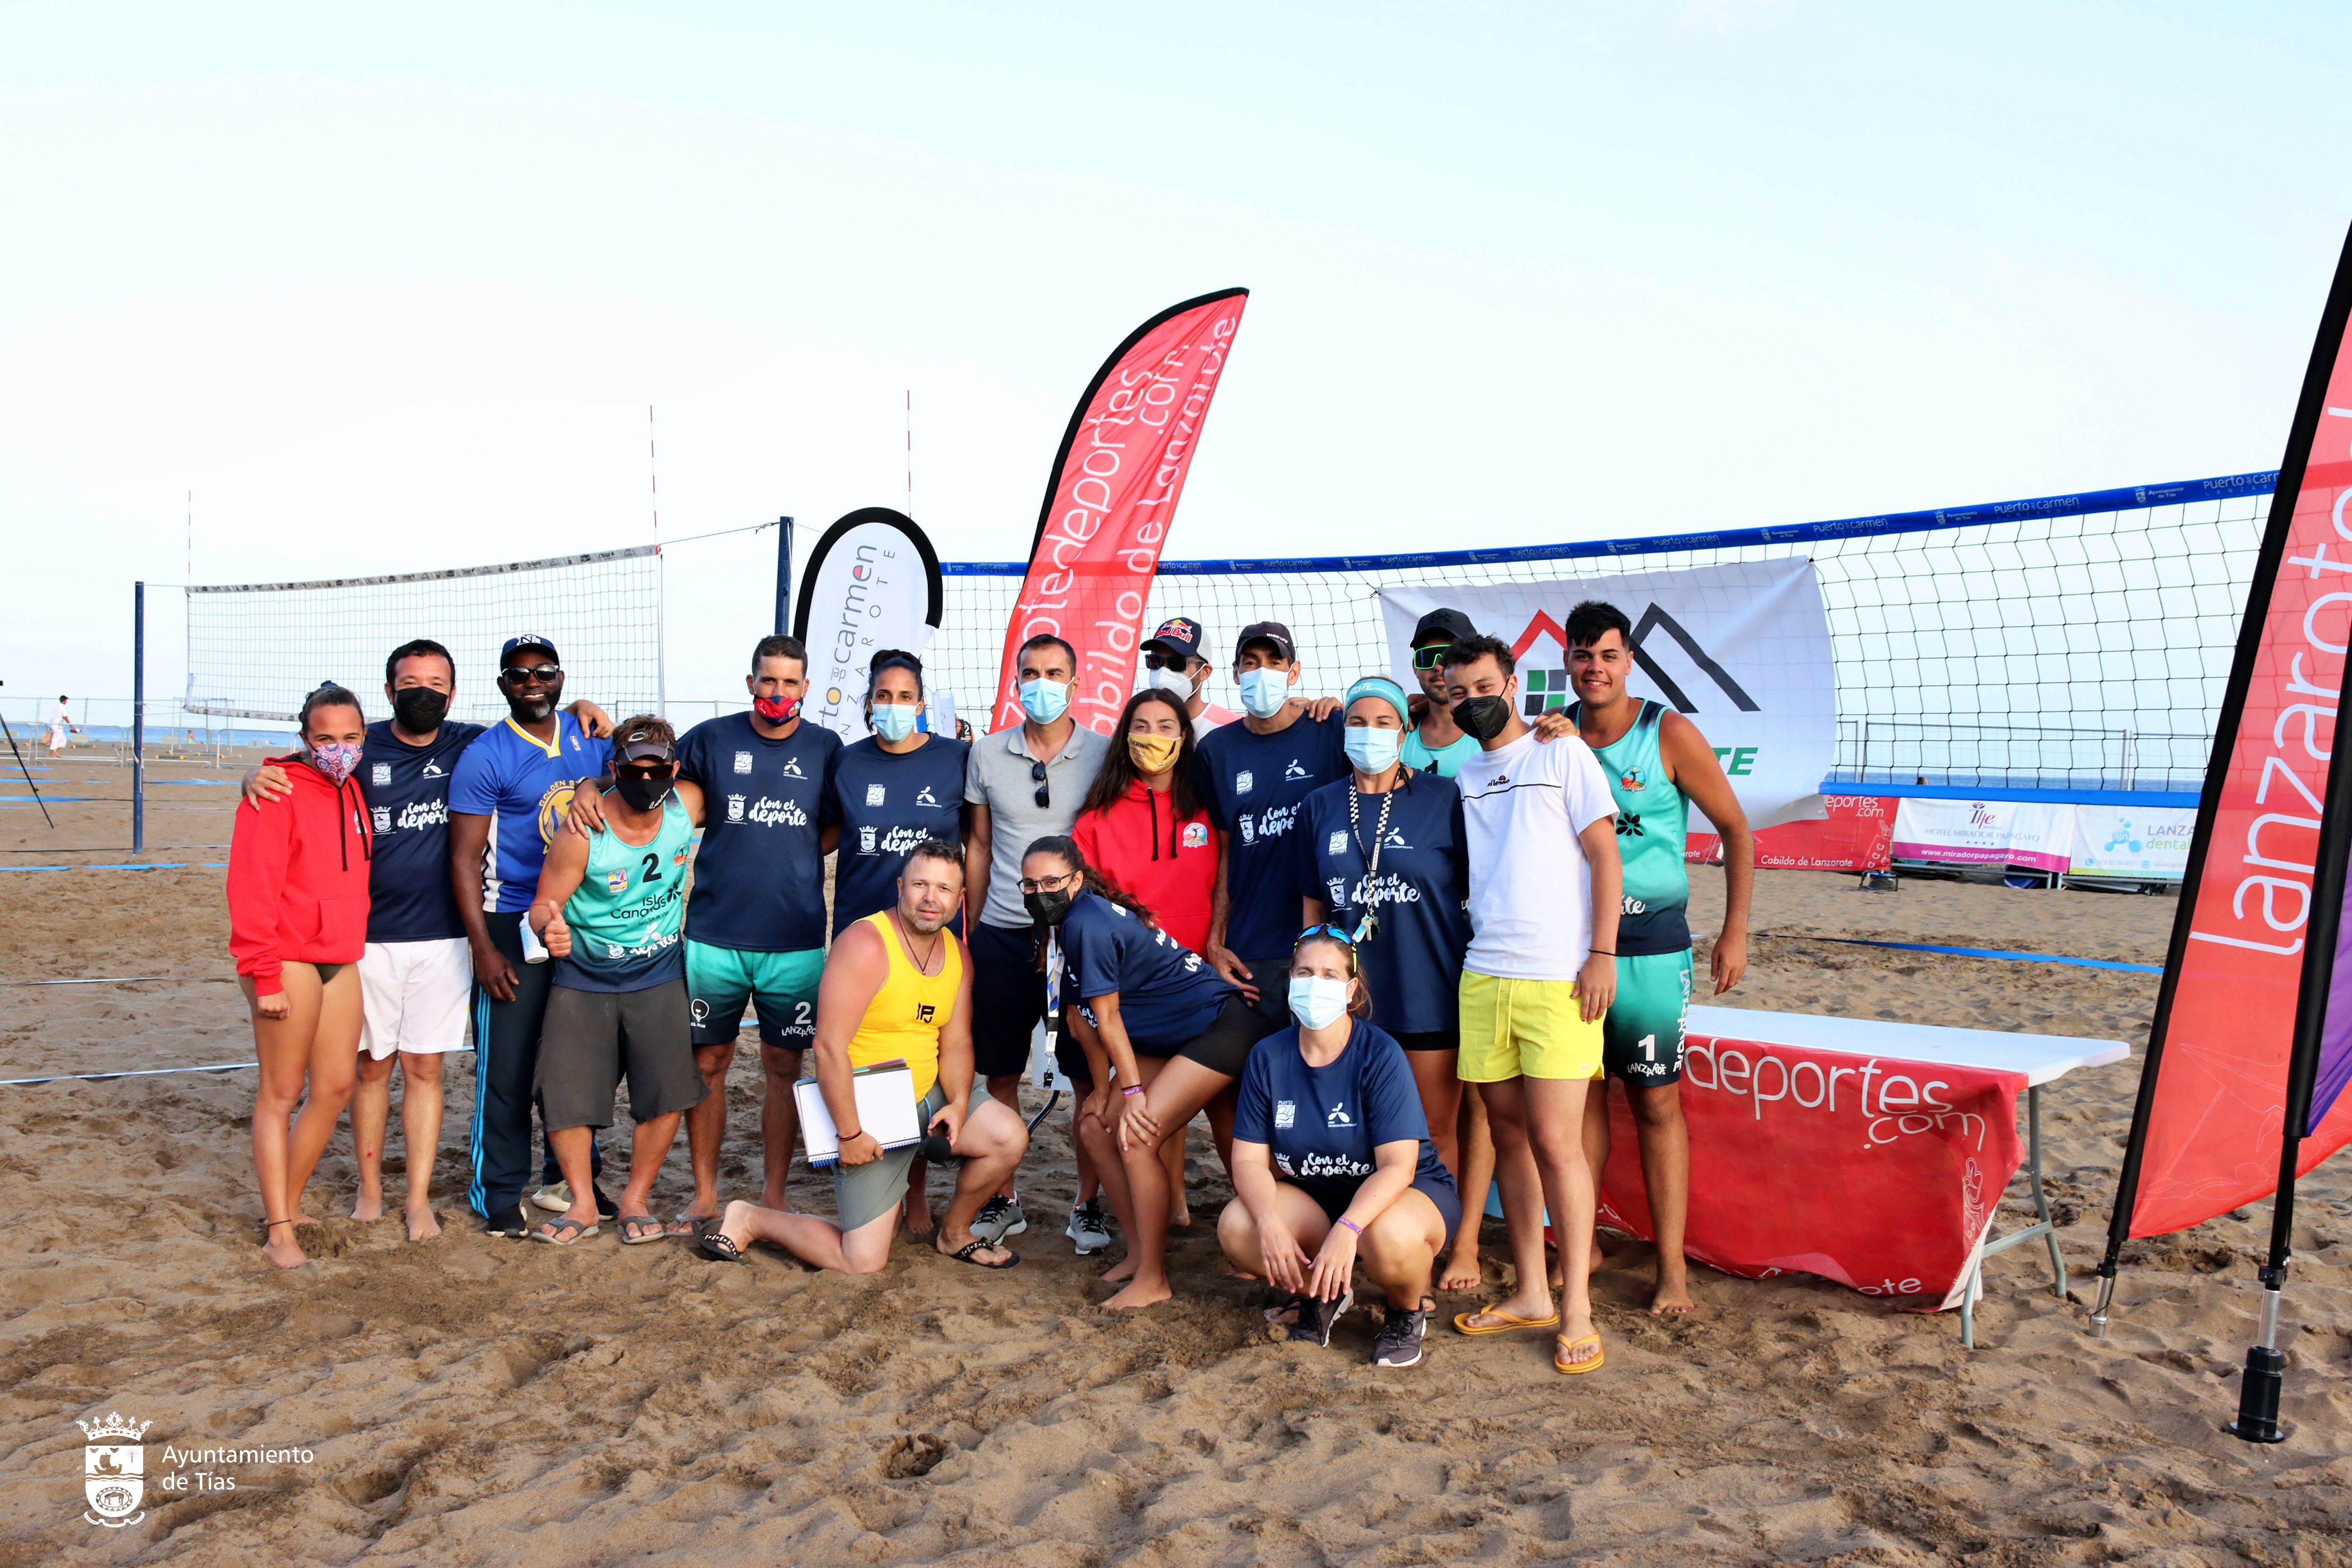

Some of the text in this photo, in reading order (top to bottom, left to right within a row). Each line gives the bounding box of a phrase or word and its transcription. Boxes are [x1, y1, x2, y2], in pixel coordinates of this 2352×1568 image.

[2204, 476, 2244, 490] Puerto
[1994, 500, 2029, 514] Puerto
[2036, 496, 2080, 509] carmen
[1813, 520, 1844, 533] Puerto
[1850, 517, 1888, 529] carmen
[1653, 534, 1720, 546] Puerto carmen
[1539, 546, 1570, 554] carmen
[834, 544, 877, 664] carmen
[1078, 590, 1142, 737] abildo
[1117, 520, 1163, 573] de
[1171, 628, 1193, 643] Bull
[840, 548, 896, 735] NZAROTE
[831, 666, 846, 682] del
[2188, 405, 2352, 956] lanzarot
[964, 724, 970, 735] 2
[1712, 747, 1759, 775] TE
[1487, 778, 1510, 787] ellesse
[539, 780, 566, 807] GOLDEN
[407, 798, 443, 815] Con el
[760, 796, 796, 810] Con el
[397, 806, 449, 831] deport
[748, 801, 808, 828] deporte
[1267, 807, 1289, 821] Con
[1855, 807, 1885, 817] .com
[892, 825, 929, 839] Con el
[1258, 815, 1295, 837] depo
[2147, 825, 2195, 836] LANZA
[1925, 828, 2040, 842] HOTEL MIRADOR PAPAGAYO
[1761, 855, 1853, 867] Cabildo de Lanzarote
[1921, 849, 2036, 863] www.miradorpapagayo.com
[642, 853, 662, 883] 2
[1362, 872, 1400, 889] Cn el
[794, 1001, 811, 1025] 2
[782, 1025, 817, 1037] LANZARO
[1638, 1034, 1655, 1061] 1
[1627, 1062, 1667, 1077] LANZAROTE
[1684, 1038, 1953, 1120] deportes
[1863, 1110, 1986, 1152] .com
[1307, 1152, 1350, 1166] Con el
[1300, 1159, 1374, 1177] deporte
